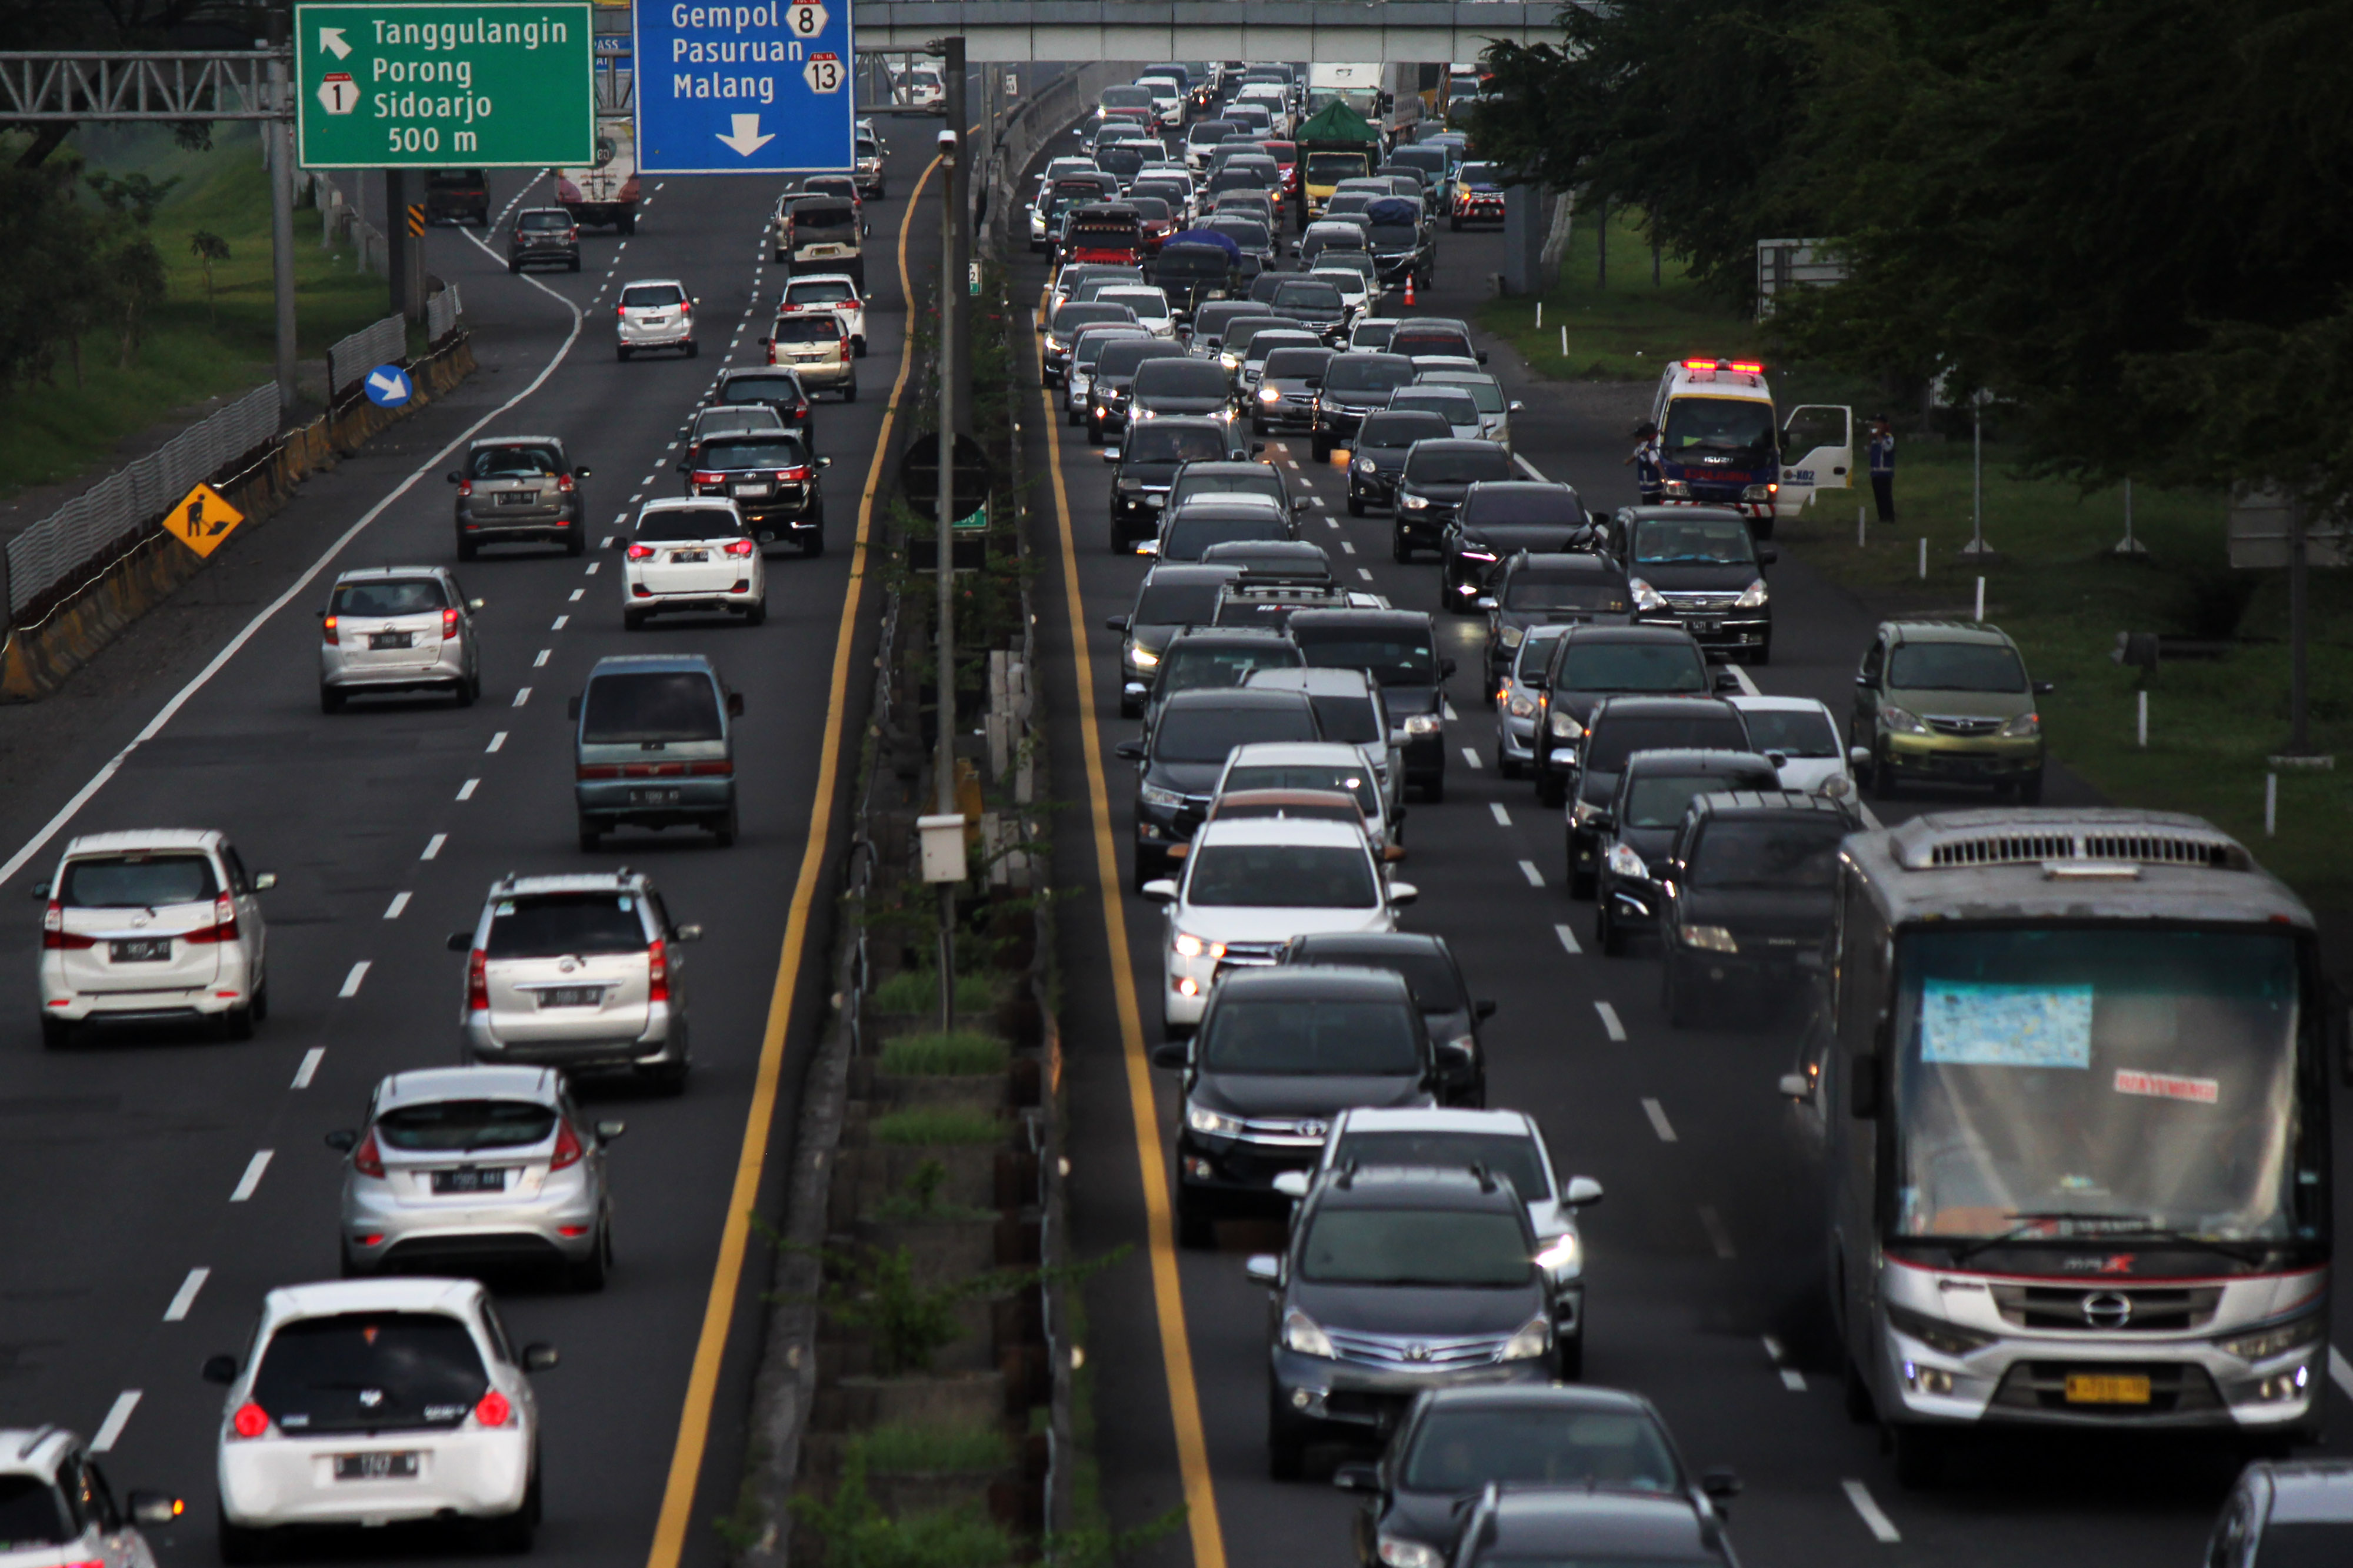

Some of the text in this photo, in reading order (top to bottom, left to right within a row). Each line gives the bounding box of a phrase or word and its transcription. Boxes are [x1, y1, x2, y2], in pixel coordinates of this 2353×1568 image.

[672, 1, 779, 34] Gempol
[799, 7, 814, 33] 8
[372, 16, 567, 51] Tanggulangin
[673, 38, 803, 63] Pasuruan
[373, 58, 472, 88] Porong
[812, 63, 836, 90] 13
[333, 84, 341, 111] 1
[674, 72, 774, 104] Malang
[374, 90, 492, 124] Sidoarjo
[389, 127, 477, 152] 500 m
